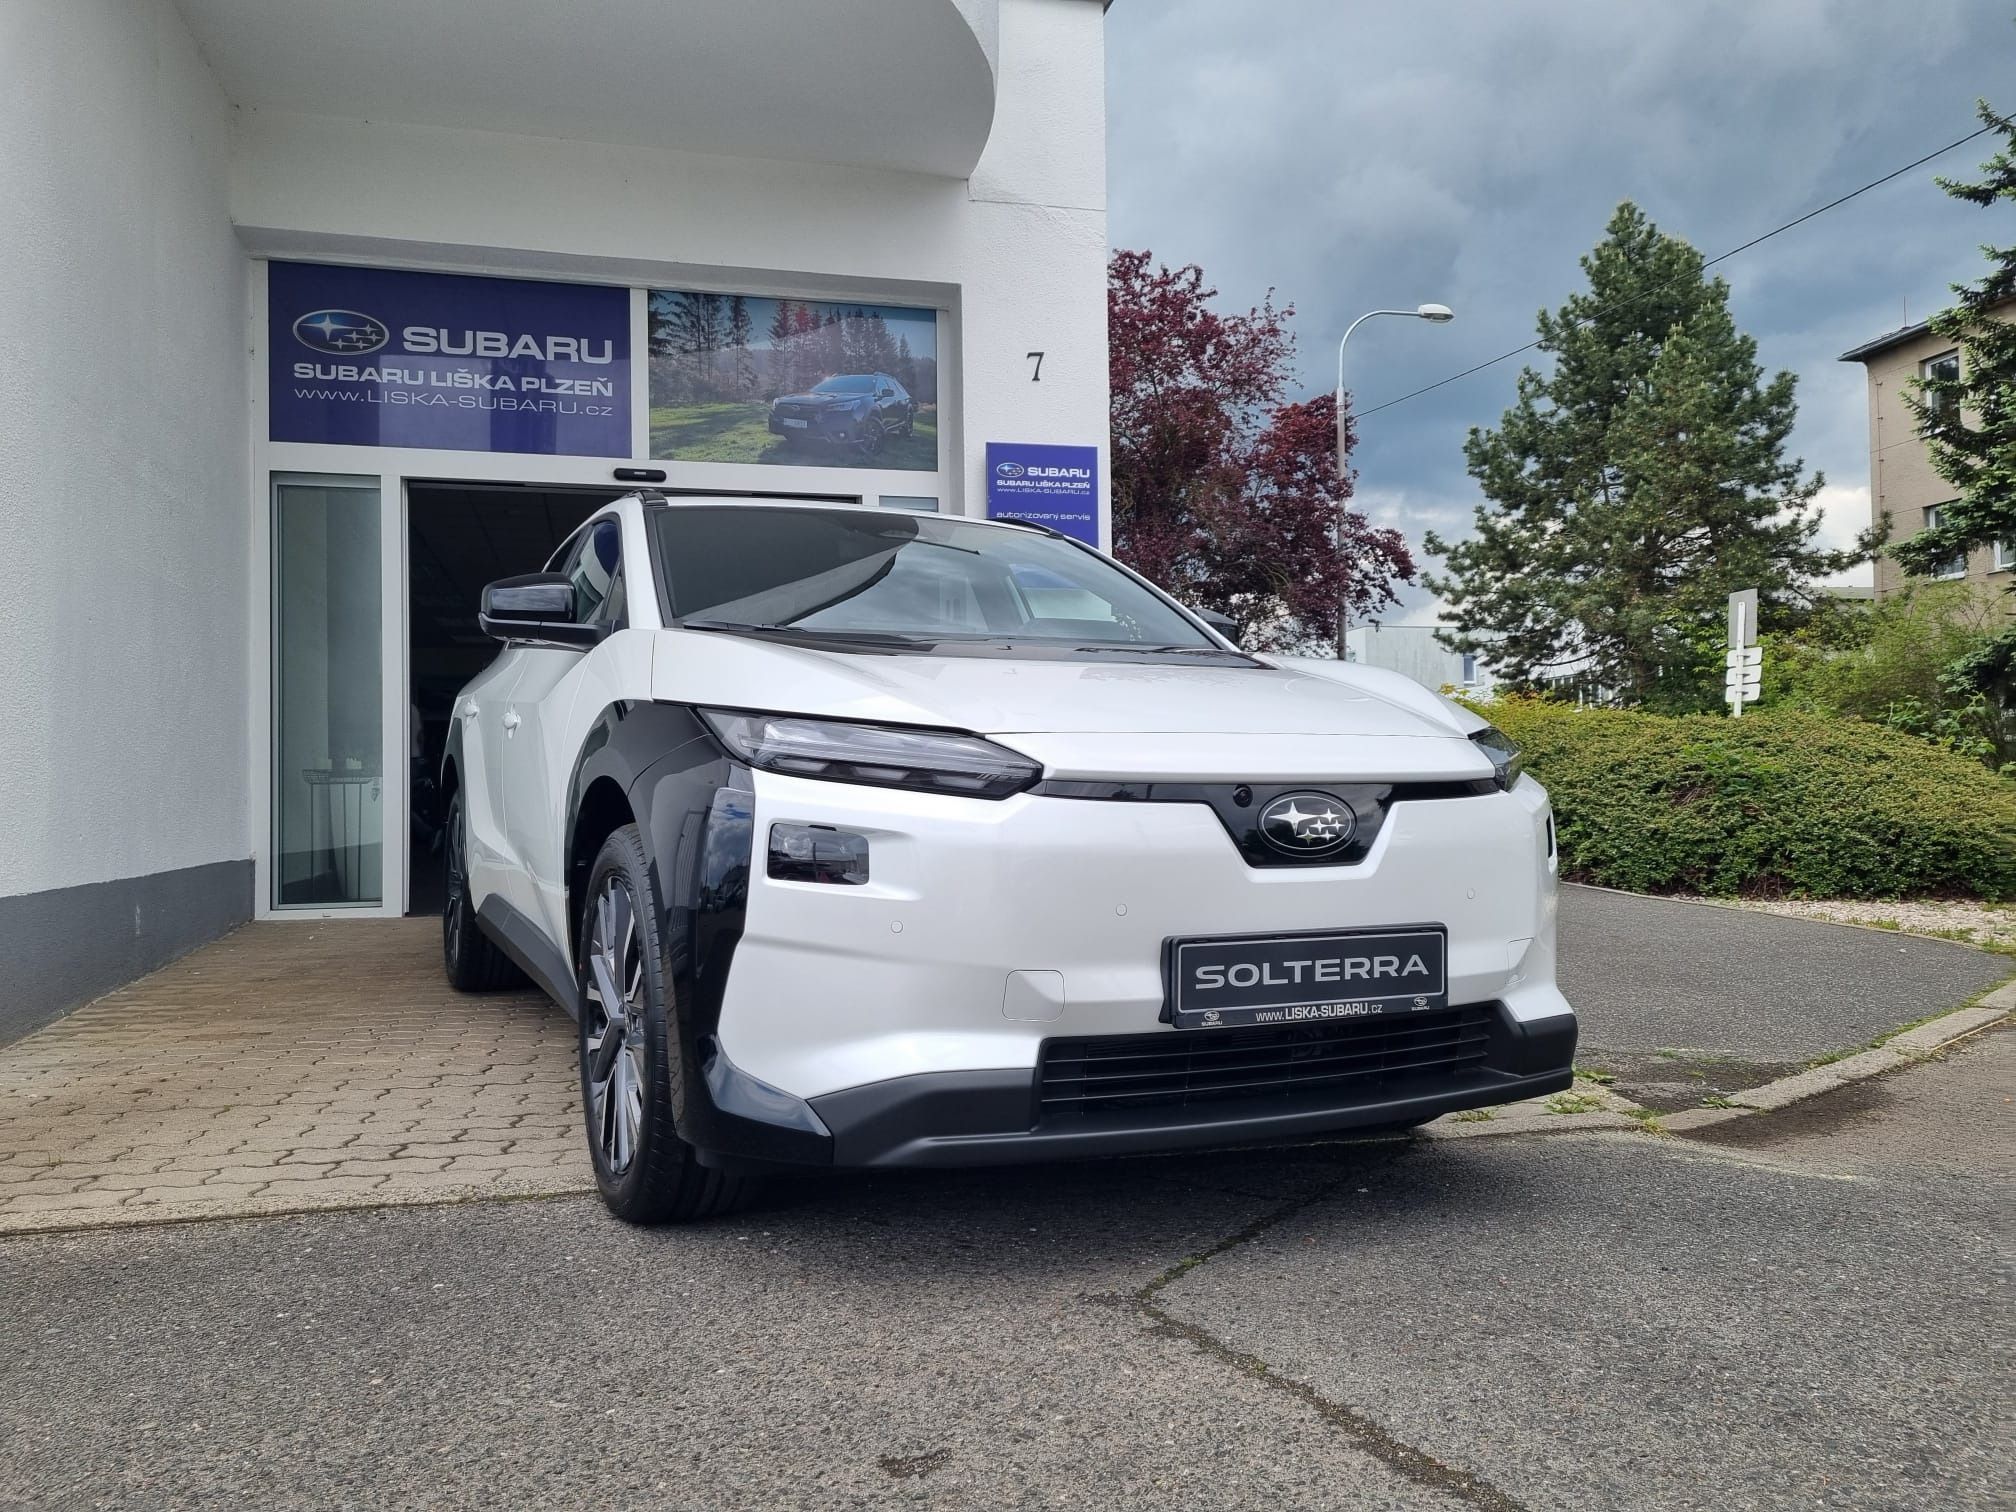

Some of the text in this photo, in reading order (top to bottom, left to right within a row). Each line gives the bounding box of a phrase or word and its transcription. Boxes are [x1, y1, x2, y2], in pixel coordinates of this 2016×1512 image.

[403, 326, 613, 364] SUBARU
[293, 362, 613, 397] SUBARU LIŠKA PLZEŇ
[1026, 351, 1045, 382] 7
[294, 388, 613, 416] www.LISKA-SUBARU.cz
[1027, 467, 1090, 478] SUBARU
[1195, 954, 1429, 990] SOLTERRA
[1255, 1002, 1383, 1022] www.LISKA-SUBARU.cz
